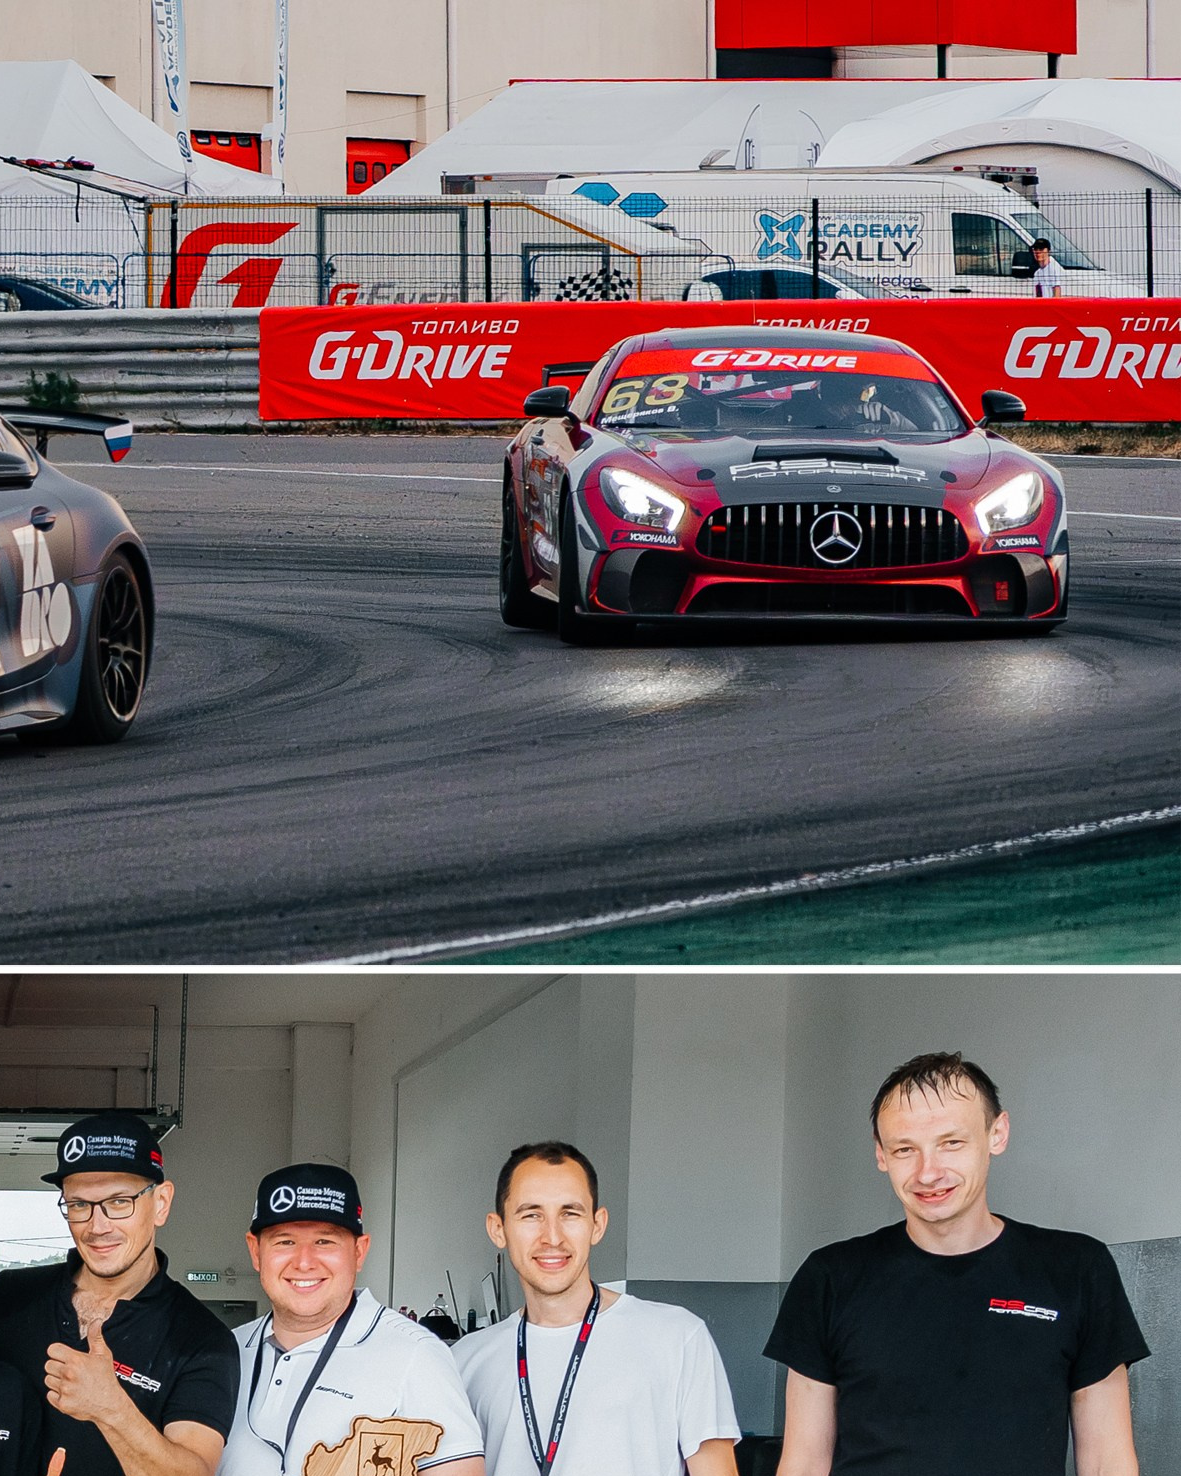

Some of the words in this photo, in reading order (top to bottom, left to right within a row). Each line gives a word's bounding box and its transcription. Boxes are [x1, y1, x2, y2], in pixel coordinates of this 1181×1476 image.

[808, 223, 919, 239] ACADEMY
[807, 241, 918, 262] RALLY
[411, 319, 520, 335] ТОПЛИВО
[1120, 317, 1181, 332] ТОПЛ
[308, 329, 512, 389] G-DRIVE
[691, 349, 858, 369] G-DRIVE
[1004, 326, 1181, 389] G-DRIV
[601, 374, 689, 414] 63
[629, 532, 677, 545] YOKOHAMA
[995, 537, 1040, 548] YOKOHAMA
[988, 1307, 1057, 1322] MOTORSPORT
